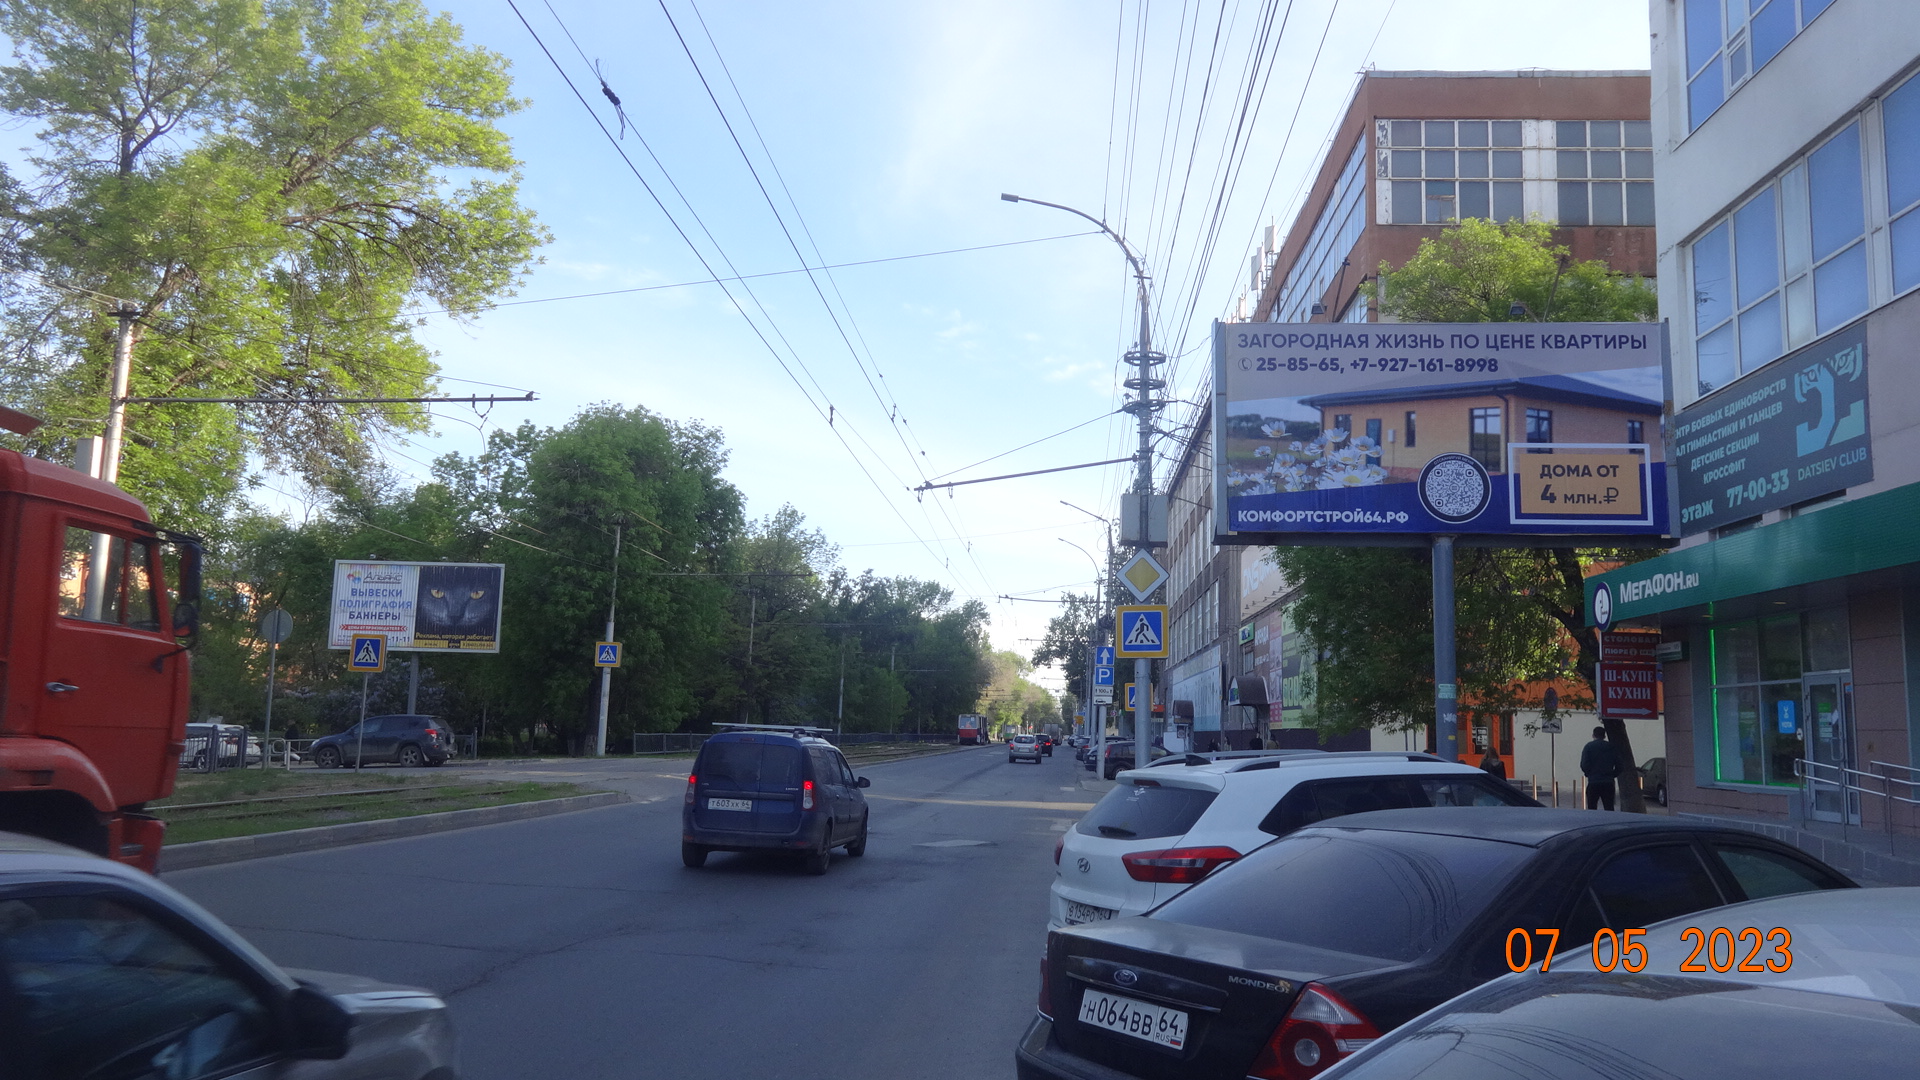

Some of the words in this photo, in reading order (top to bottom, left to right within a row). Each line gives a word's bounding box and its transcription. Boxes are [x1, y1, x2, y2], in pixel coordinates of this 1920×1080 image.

[1238, 333, 1371, 350] ЗАГОРОДНАЯ
[1375, 333, 1444, 350] ЖИЗНЬ
[1450, 334, 1479, 350] ПО
[1485, 334, 1535, 352] ЦЕНЕ
[1541, 334, 1647, 350] КВАРТИРЫ
[1256, 357, 1345, 374] 25-85-65,
[1350, 357, 1499, 373] +7-927-161-8998
[1691, 409, 1723, 433] БОЕВЫХ
[1724, 379, 1787, 418] ЕДИНОБОРСТВ
[1686, 421, 1739, 454] ГИМНАСТИКИ
[1740, 419, 1746, 431] И
[1747, 401, 1783, 427] ТАНЦЕВ
[1691, 446, 1725, 471] ДЕТСКИЕ
[1726, 432, 1760, 457] СЕКЦИИ
[1539, 464, 1593, 480] ДОМА
[1596, 464, 1620, 479] ОТ
[1703, 458, 1746, 485] КРОССФИТ
[1797, 456, 1838, 481] DATSIEV
[1839, 447, 1868, 467] CLUB
[1540, 485, 1557, 504] 4
[1726, 468, 1790, 508] 77-00-33
[1238, 508, 1409, 525] КОМФОРТСТРОЙ64.РФ
[350, 588, 403, 598] ВЫВЕСКИ
[339, 599, 412, 610] ПОЛИГРАФИЯ
[348, 611, 401, 621] БАННЕРЫ
[1604, 669, 1655, 683] Ш-КУПЕ
[1608, 687, 1652, 700] КУХНИ
[1158, 1011, 1179, 1034] 64
[1155, 1032, 1170, 1043] RUS
